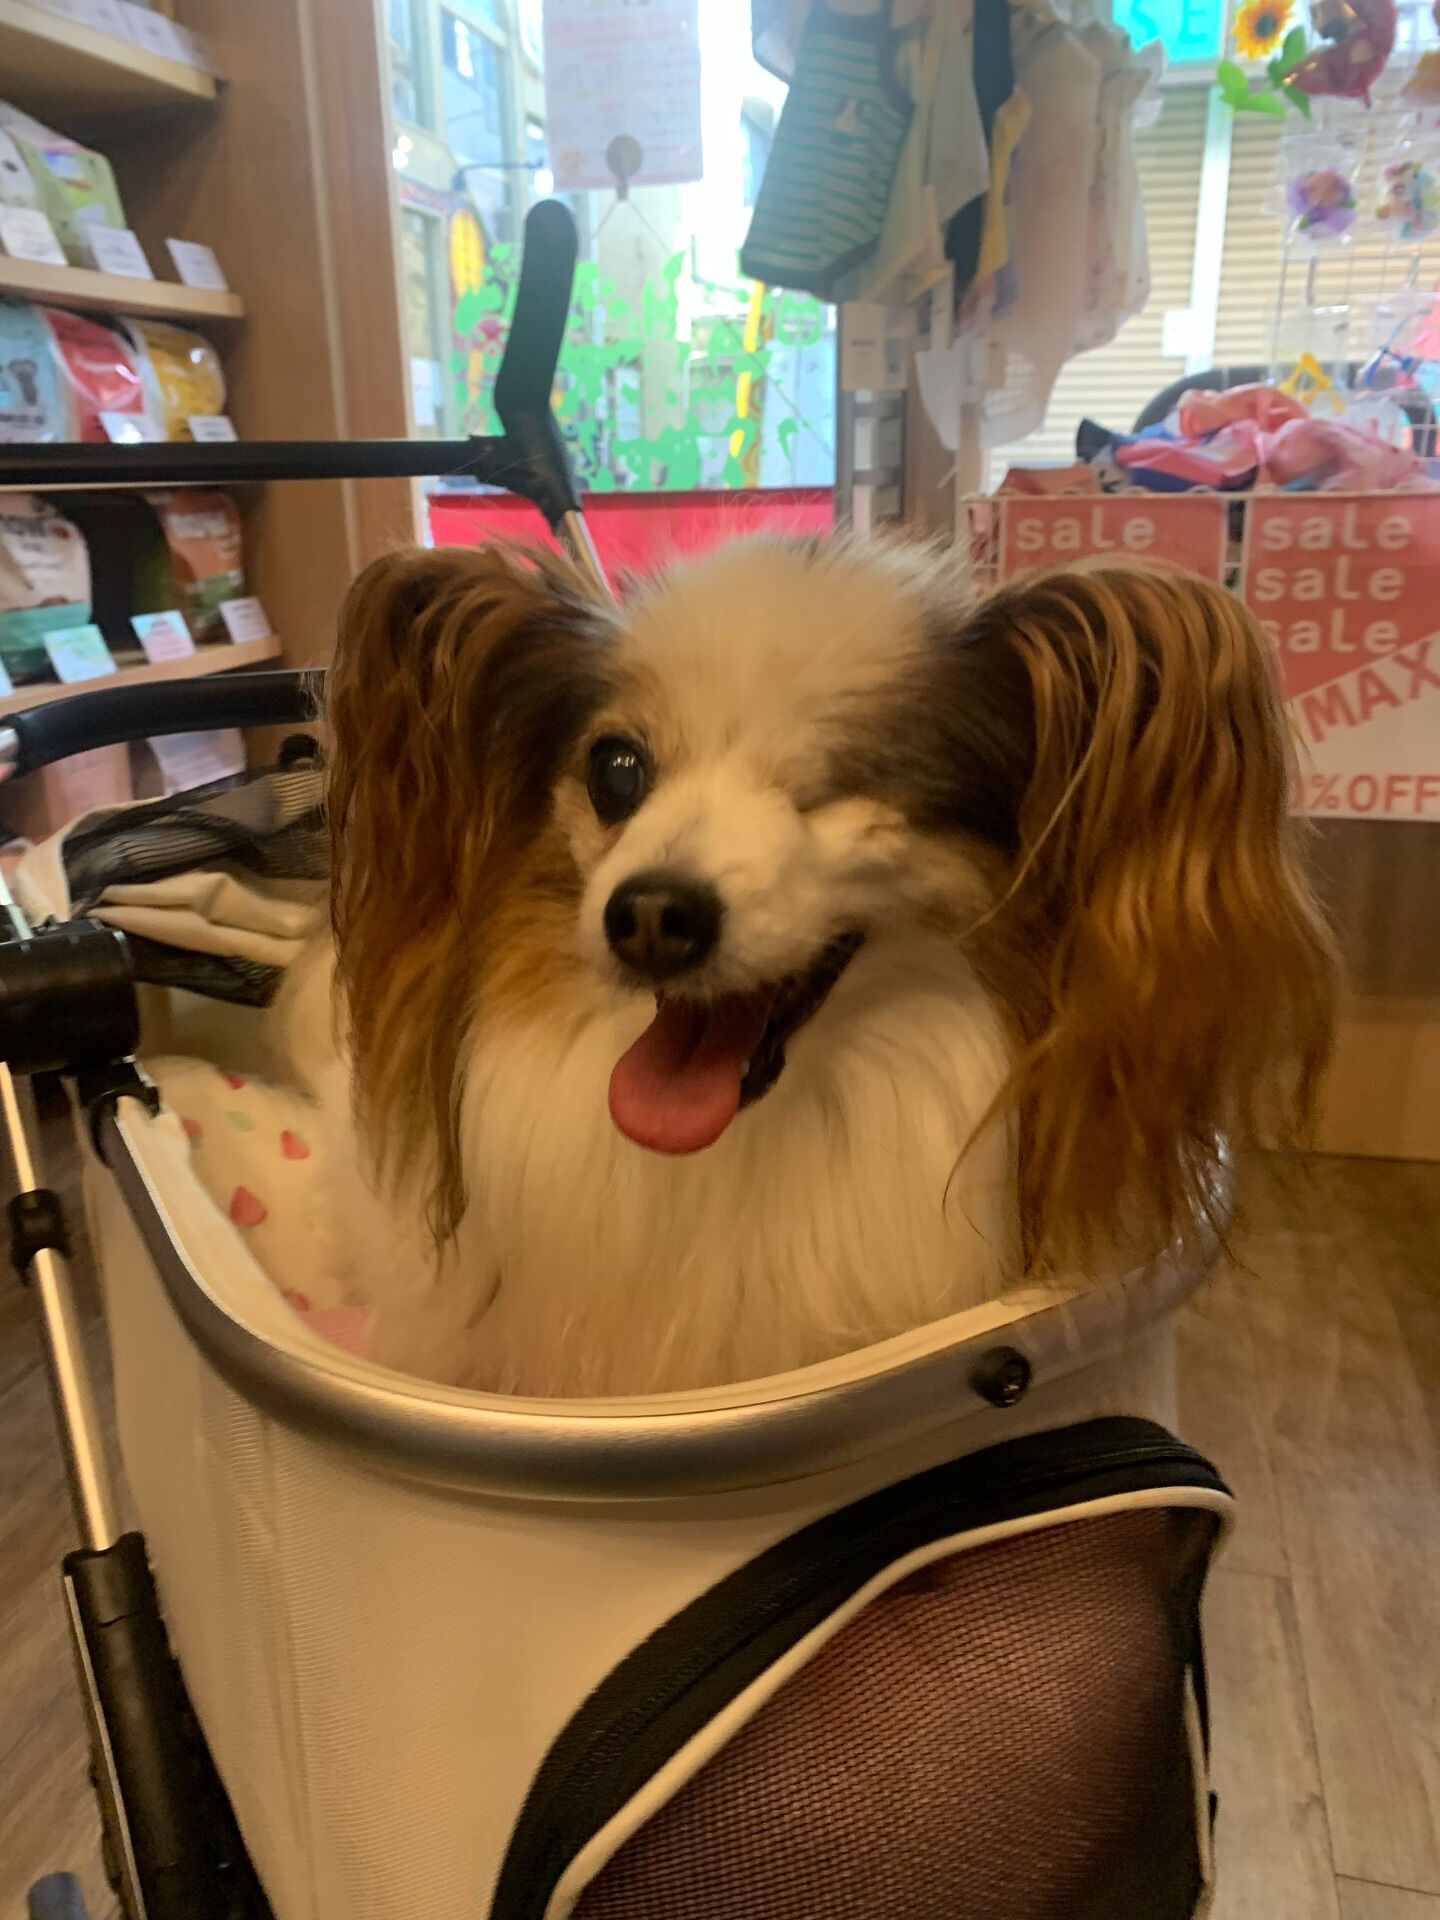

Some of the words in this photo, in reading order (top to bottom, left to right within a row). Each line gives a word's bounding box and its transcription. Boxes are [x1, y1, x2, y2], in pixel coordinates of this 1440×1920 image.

[1016, 506, 1156, 550] sale
[1261, 503, 1412, 551] sale
[1255, 555, 1405, 600] sale
[1302, 641, 1440, 743] MAX
